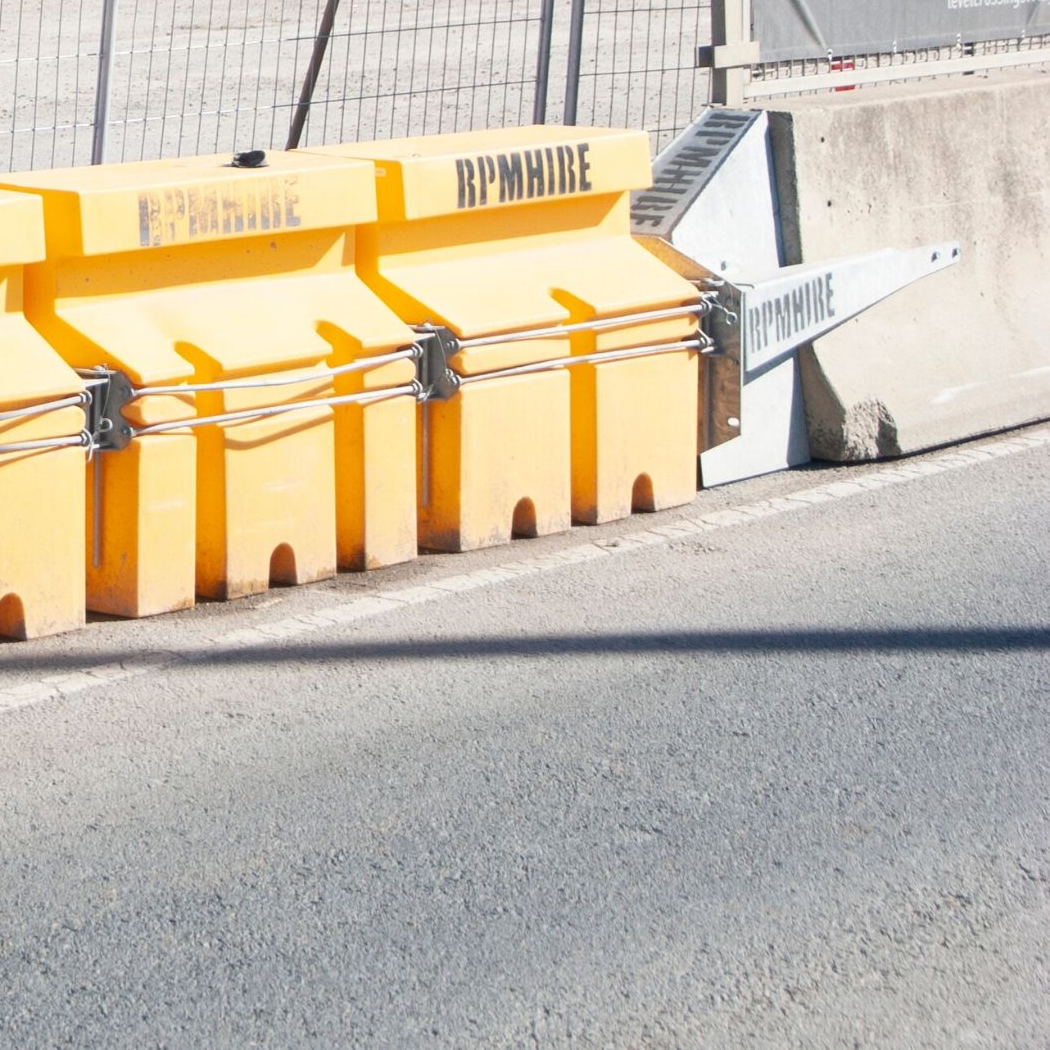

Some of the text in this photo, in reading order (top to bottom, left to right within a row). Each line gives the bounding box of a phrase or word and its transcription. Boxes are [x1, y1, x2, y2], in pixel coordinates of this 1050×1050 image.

[455, 143, 592, 209] RPMHIRE
[630, 112, 751, 227] RPMHIRE
[749, 272, 835, 354] RPMHIRE
